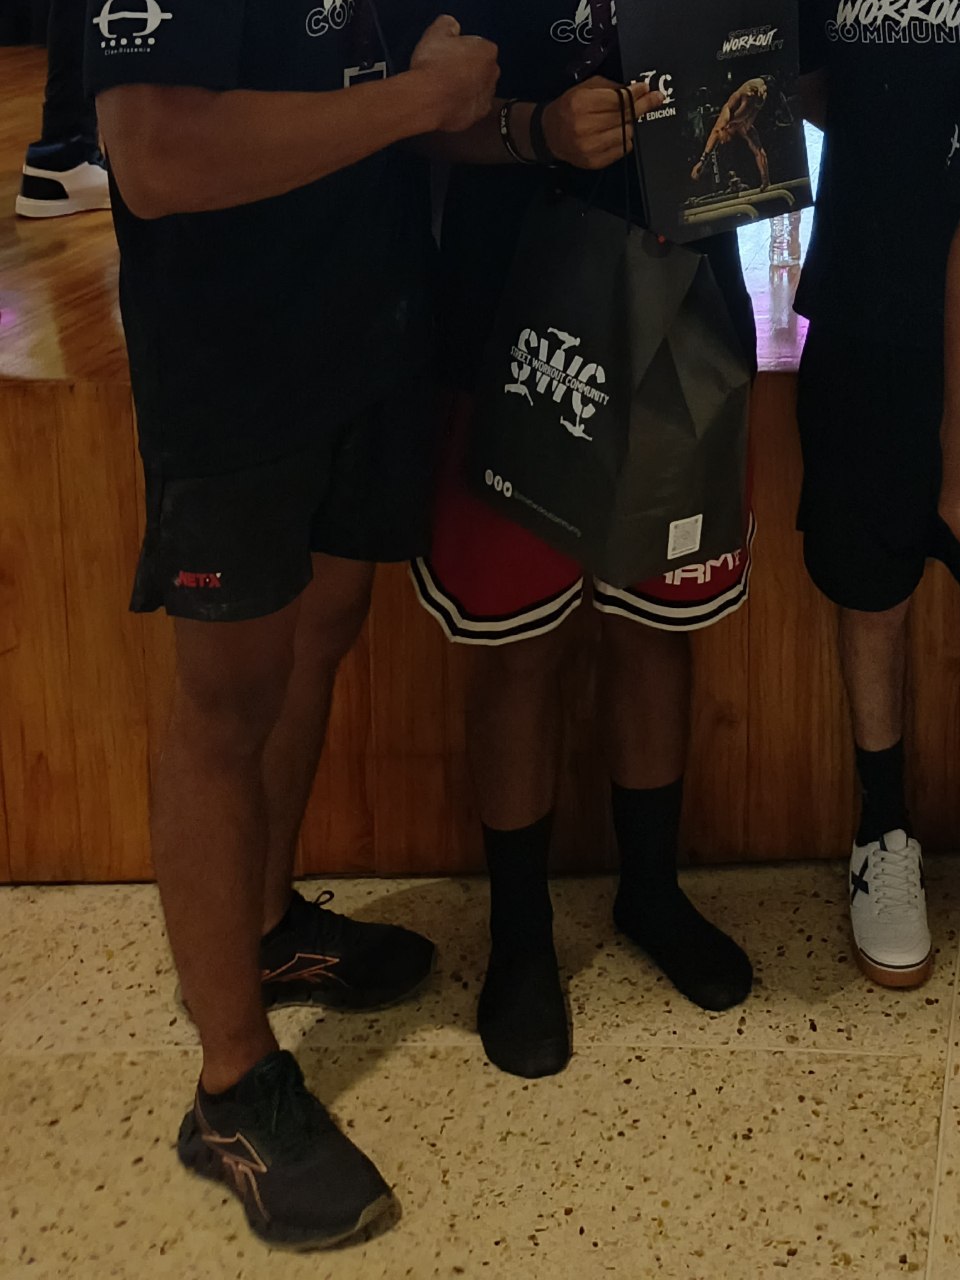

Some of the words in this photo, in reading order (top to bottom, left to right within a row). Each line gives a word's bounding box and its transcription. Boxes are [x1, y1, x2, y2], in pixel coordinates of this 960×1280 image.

[722, 28, 778, 53] WORKOUT
[646, 107, 676, 121] EDICIÓN
[504, 327, 606, 434] SWC
[510, 346, 532, 365] STREET
[532, 358, 566, 382] WORKOUT
[565, 376, 610, 406] COMMUNITY
